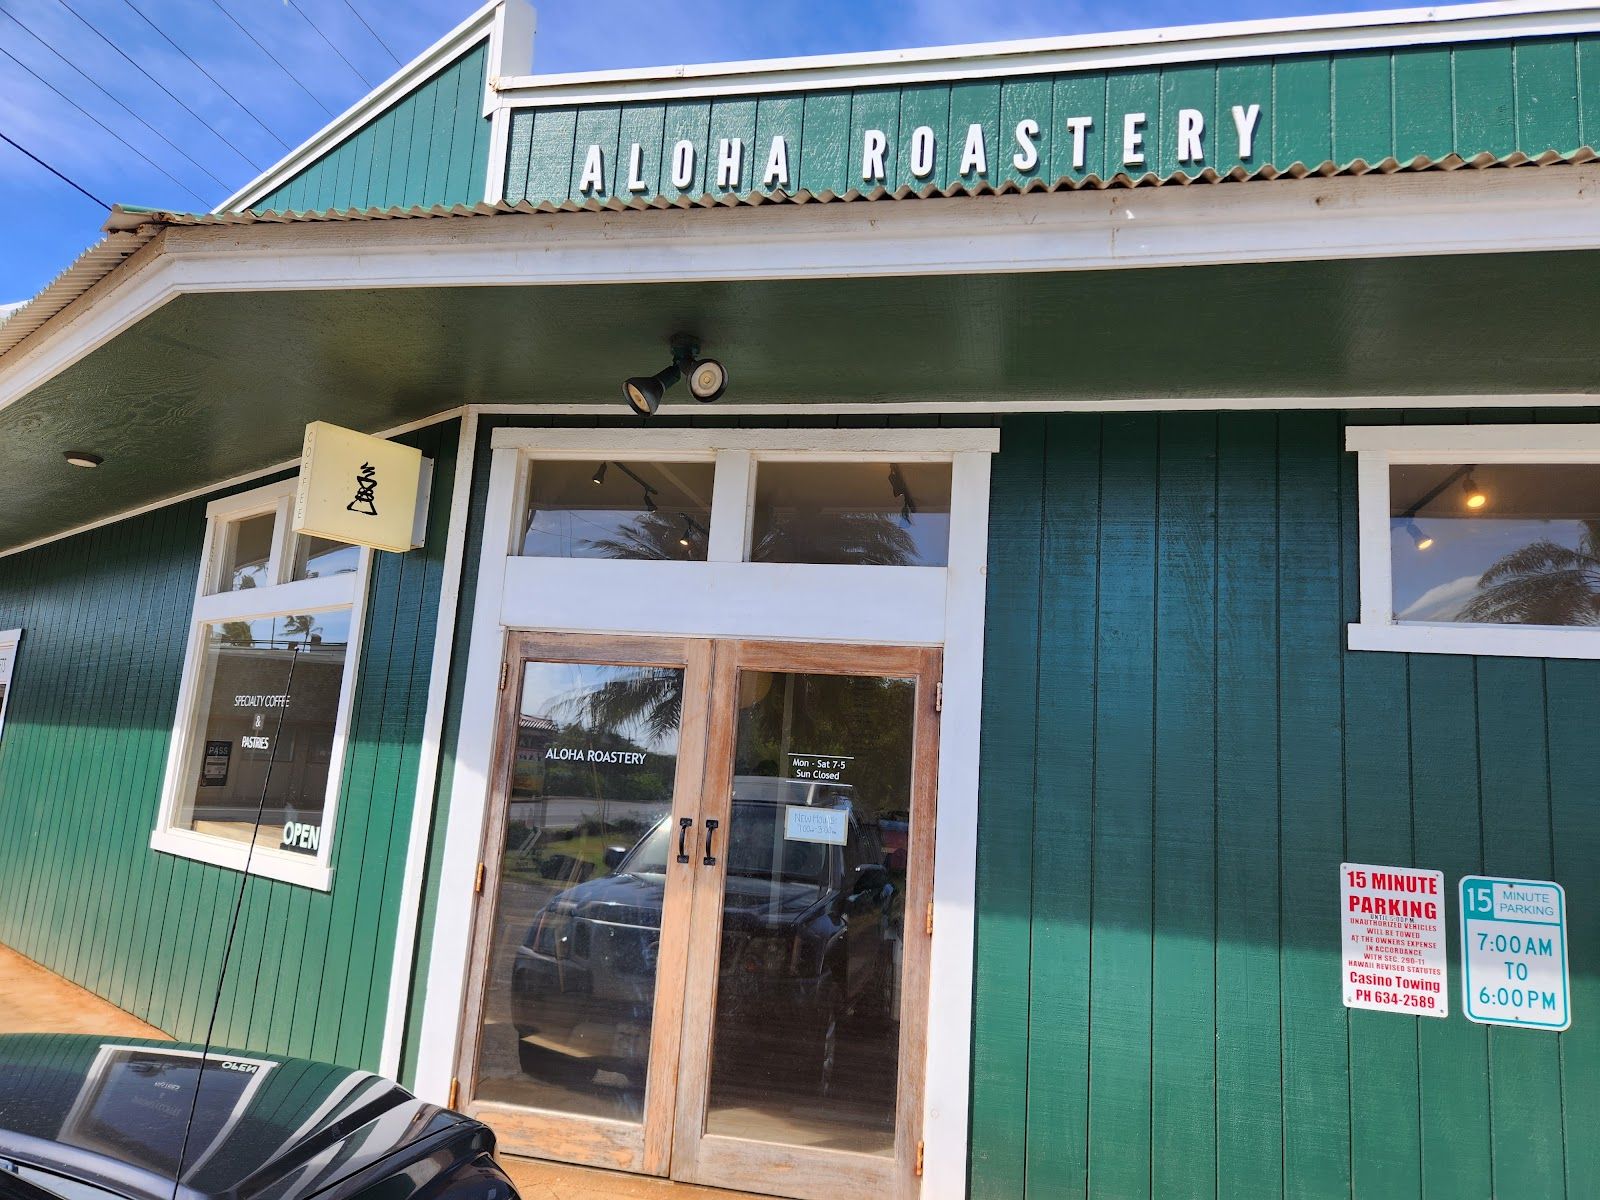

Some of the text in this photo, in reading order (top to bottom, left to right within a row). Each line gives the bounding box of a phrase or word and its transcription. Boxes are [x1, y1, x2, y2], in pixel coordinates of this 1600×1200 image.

[579, 103, 1262, 193] ALOHA ROASTERY
[234, 695, 291, 708] SPECIALTY COFFEE
[255, 715, 261, 728] &
[241, 736, 270, 750] PASTRIES
[545, 748, 647, 765] ALOHA ROASTERY
[792, 758, 809, 767] Mon
[817, 759, 830, 769] Sat
[833, 761, 846, 770] 7-5
[796, 769, 840, 780] Sun Closed
[283, 821, 321, 850] OPEN
[1347, 871, 1438, 895] 15 MINUTE
[1467, 887, 1493, 913] 15
[1503, 891, 1550, 904] MINUTE
[1349, 895, 1437, 920] PARKING
[1500, 903, 1554, 916] PARKING
[1350, 918, 1437, 932] UNAUTHORIZED VEHICLES
[1367, 928, 1421, 939] WILL BE TOWED
[1351, 935, 1360, 943] AT
[1375, 937, 1405, 946] OWNERS
[1407, 940, 1437, 949] EXPENSE
[1375, 946, 1422, 956] ACCORDANCE
[1364, 953, 1425, 965] WITH SEC. 290-11
[1348, 960, 1441, 976] HAWAII REVISED STATUTES
[1504, 961, 1528, 981] TO
[1350, 971, 1440, 994] Casino Towing
[1356, 989, 1435, 1009] PH 634-2589
